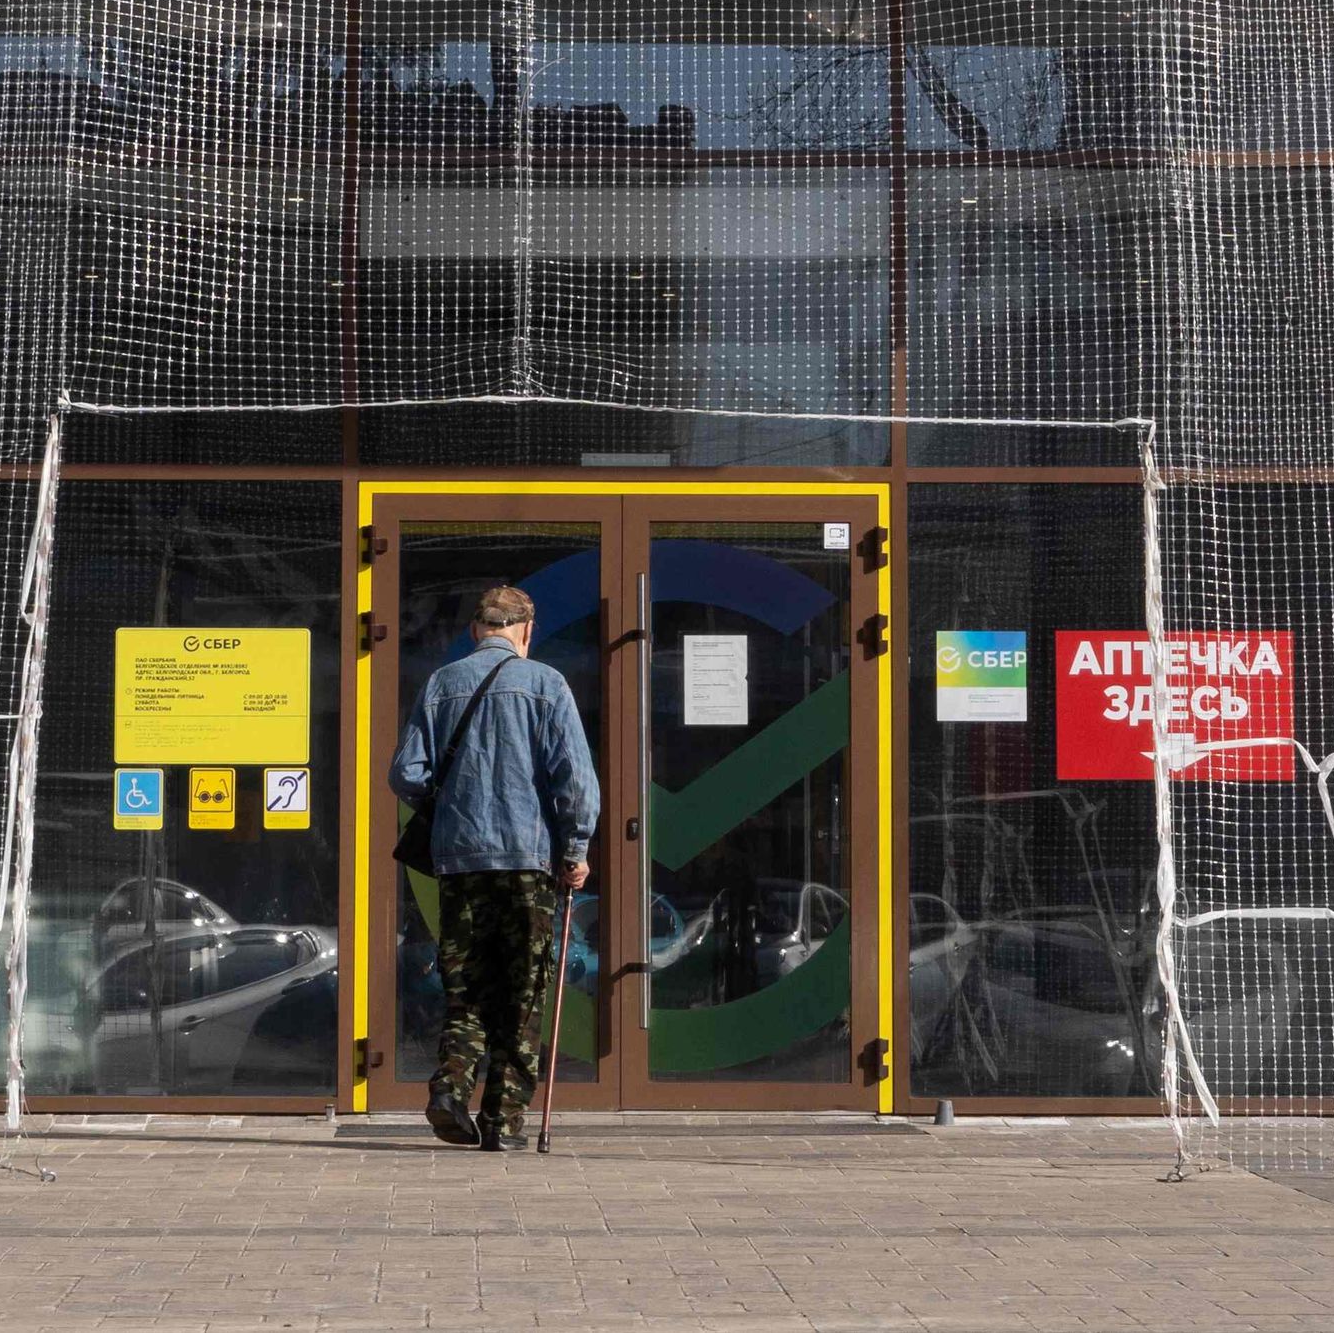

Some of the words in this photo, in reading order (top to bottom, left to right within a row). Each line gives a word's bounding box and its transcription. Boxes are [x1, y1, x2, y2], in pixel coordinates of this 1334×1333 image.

[203, 638, 241, 650] СБЕР
[967, 650, 1027, 668] СБЕР
[1068, 640, 1283, 677] АПТЕЧКА
[1102, 685, 1249, 727] ЗДЕСЬ
